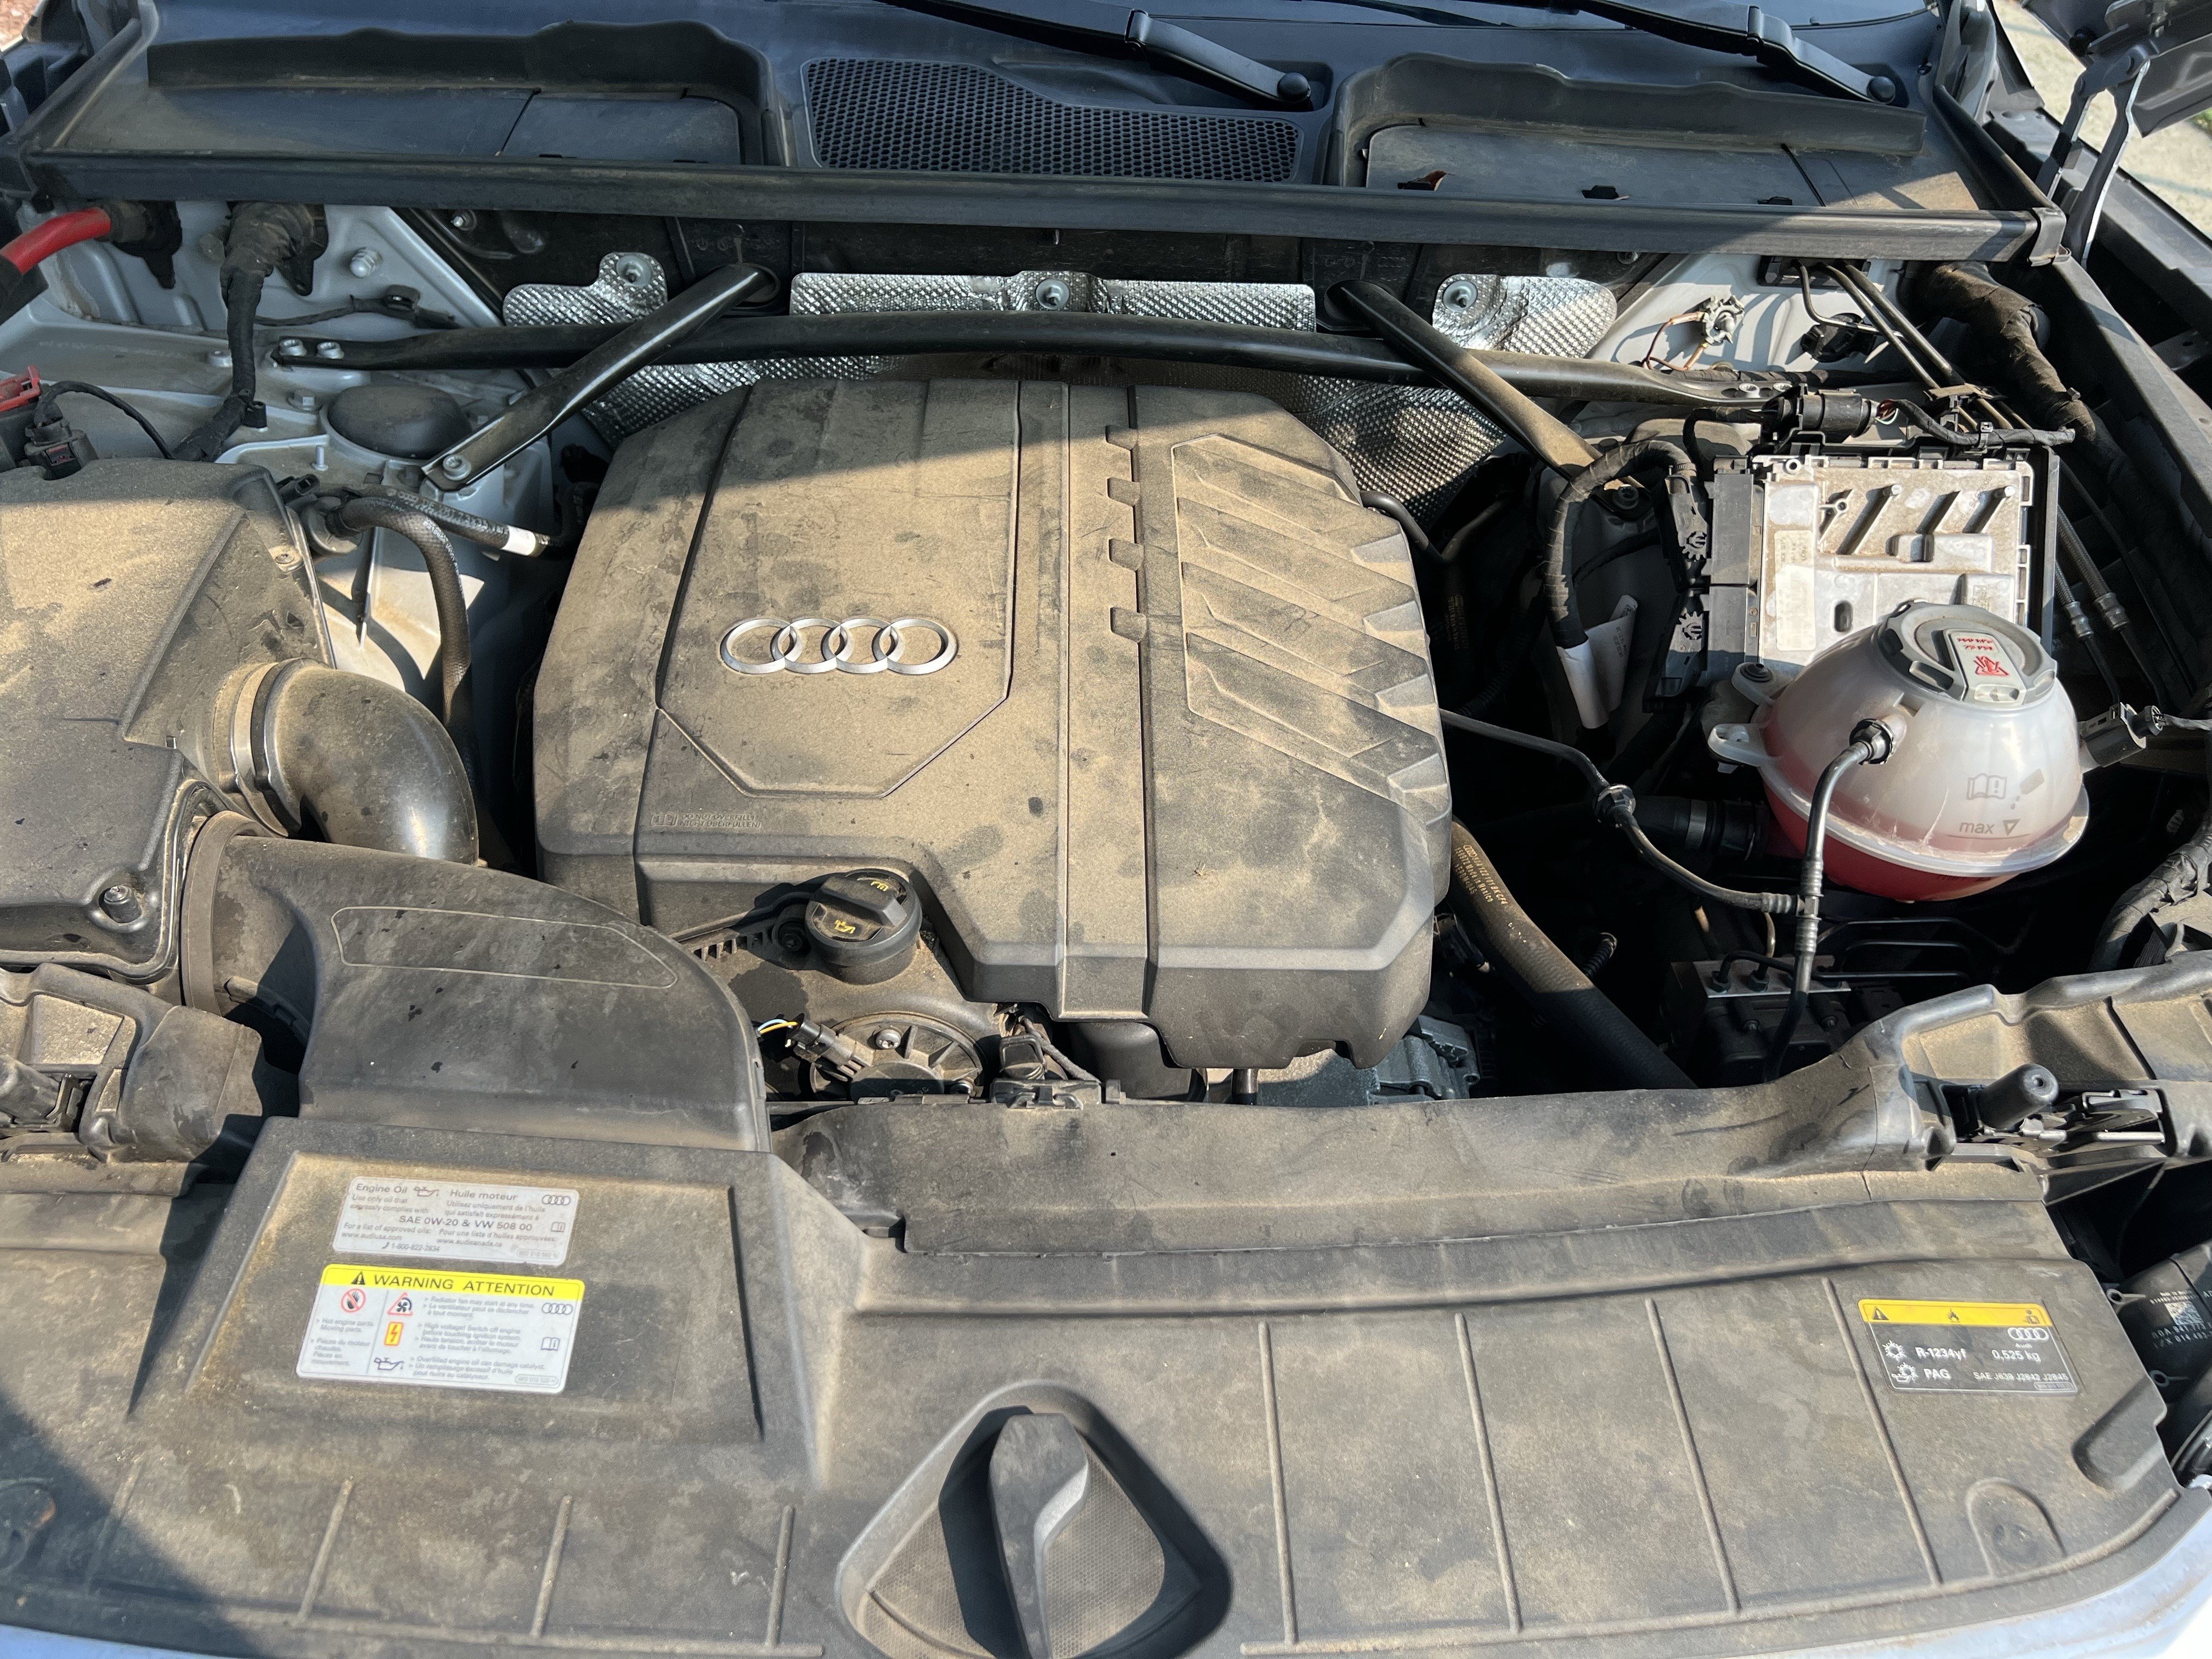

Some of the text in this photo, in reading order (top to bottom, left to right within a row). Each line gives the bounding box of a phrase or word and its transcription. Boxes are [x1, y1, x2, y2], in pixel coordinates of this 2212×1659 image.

[1959, 822, 1995, 834] max
[1465, 864, 1477, 878] Made
[1479, 883, 1493, 902] Mexico
[355, 1183, 408, 1194] Engine Oil
[449, 1189, 518, 1201] Huile moteur
[349, 1203, 381, 1211] expressly
[382, 1205, 413, 1214] complies
[472, 1203, 513, 1211] uniquement
[398, 1215, 421, 1223] SAE
[423, 1217, 459, 1226] 0W-20
[473, 1220, 494, 1228] VW
[496, 1221, 516, 1229] 508
[518, 1223, 533, 1231] 00
[382, 1225, 415, 1234] approved
[341, 1231, 403, 1240] www.audiusa.com
[436, 1238, 503, 1247] www.audicanada.ca
[373, 1274, 555, 1296] WARNING ATTENTION
[1915, 1347, 2041, 1363] R-1234yf 0,525 kg
[426, 1363, 464, 1372] remplissage
[1923, 1369, 1951, 1379] PAG
